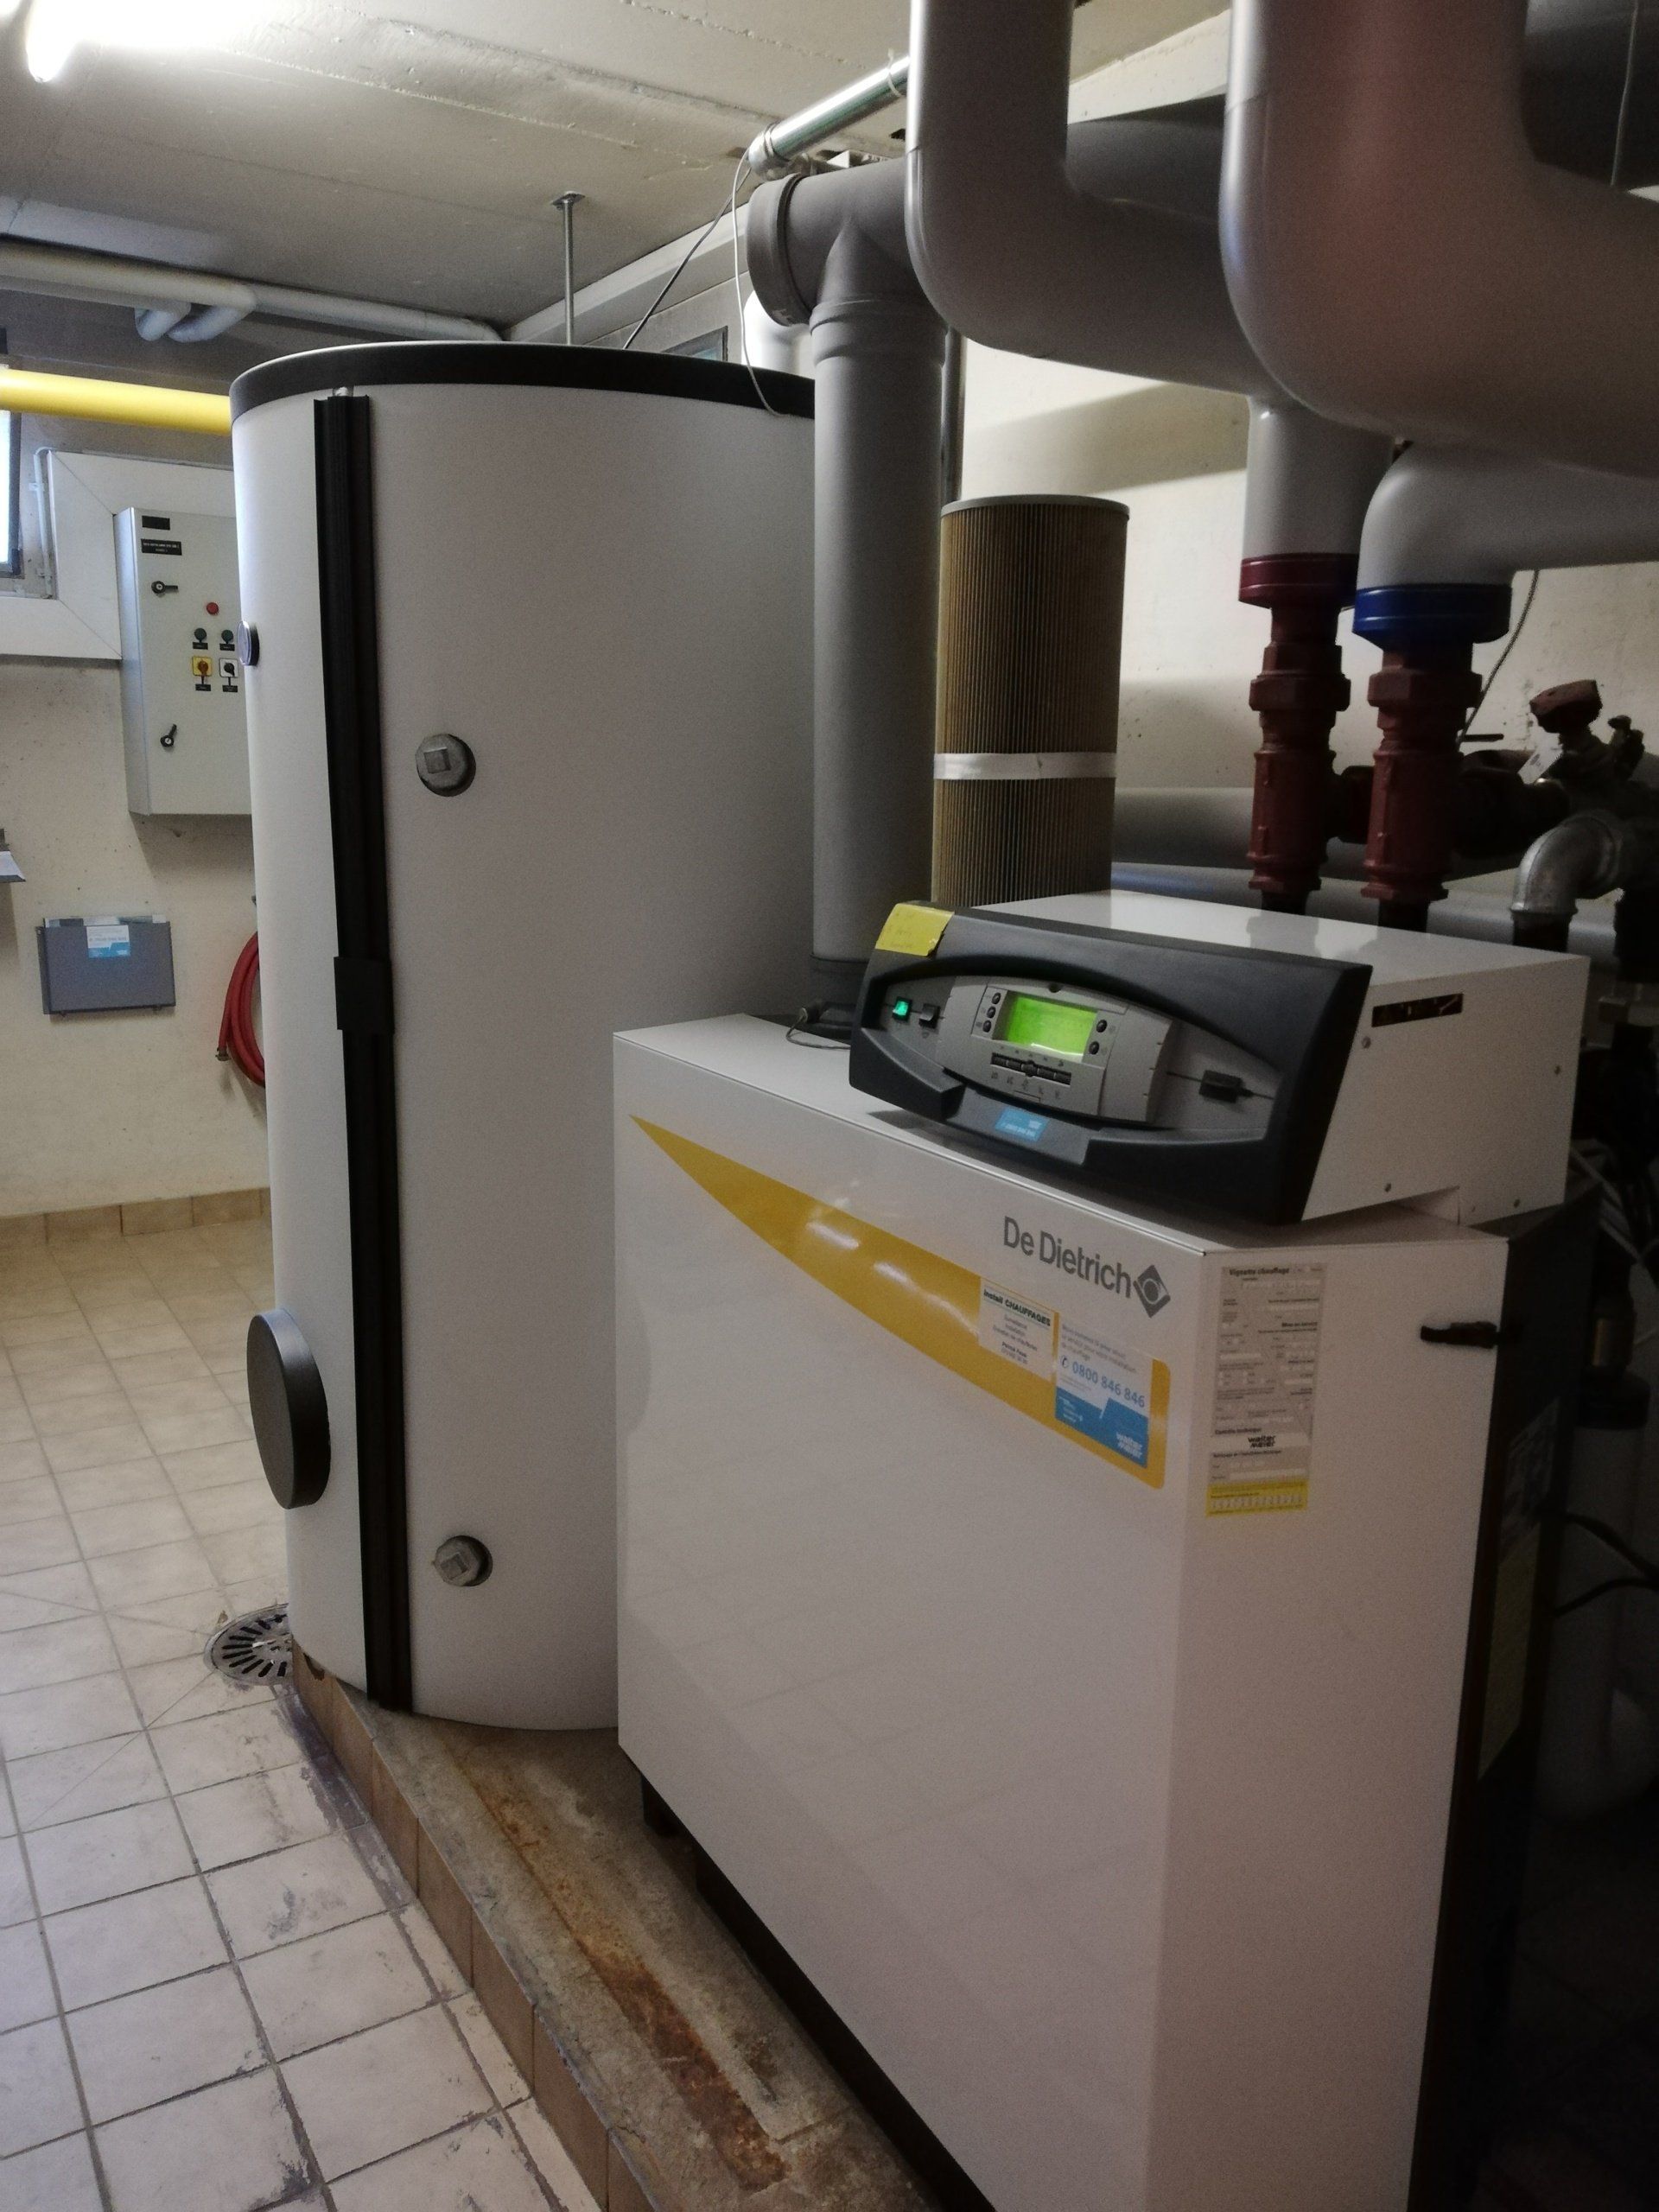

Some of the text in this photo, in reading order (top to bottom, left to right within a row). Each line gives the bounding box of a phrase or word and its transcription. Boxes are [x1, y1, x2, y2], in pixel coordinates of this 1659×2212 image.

[1003, 1216, 1132, 1300] De Dietrich
[1004, 1299, 1051, 1326] CHAUFFAGES
[1071, 1361, 1098, 1384] 0800
[1101, 1376, 1122, 1395] 846
[1123, 1388, 1146, 1408] 846
